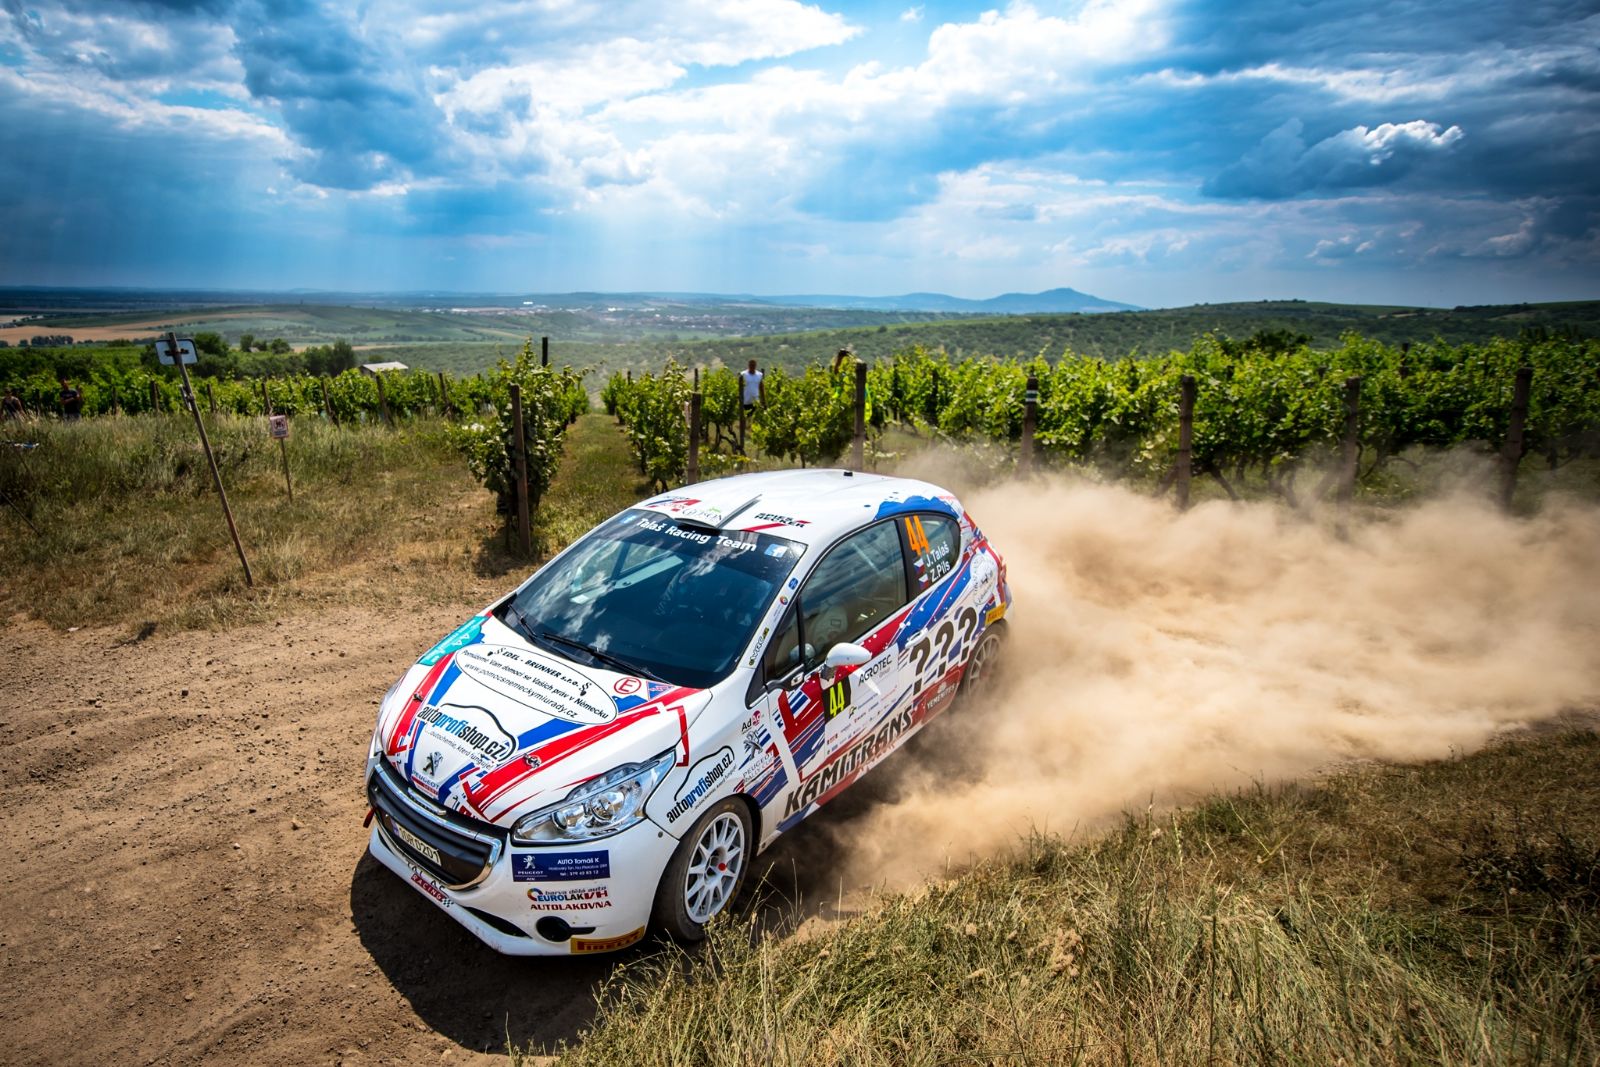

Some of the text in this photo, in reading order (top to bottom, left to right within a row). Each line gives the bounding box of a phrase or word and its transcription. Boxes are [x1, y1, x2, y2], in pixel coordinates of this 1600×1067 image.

[636, 518, 757, 551] Talaš Racing Team
[904, 514, 930, 557] 44
[525, 660, 561, 678] BRUNNER
[858, 654, 892, 686] AGROTEC
[829, 681, 845, 718] 44
[417, 706, 505, 760] autoprofishop.cz
[783, 704, 913, 819] KAMITRANS
[666, 752, 734, 823] autoprofishop.cz
[411, 873, 442, 900] RACING
[530, 900, 612, 911] AUTOLAKOVNA
